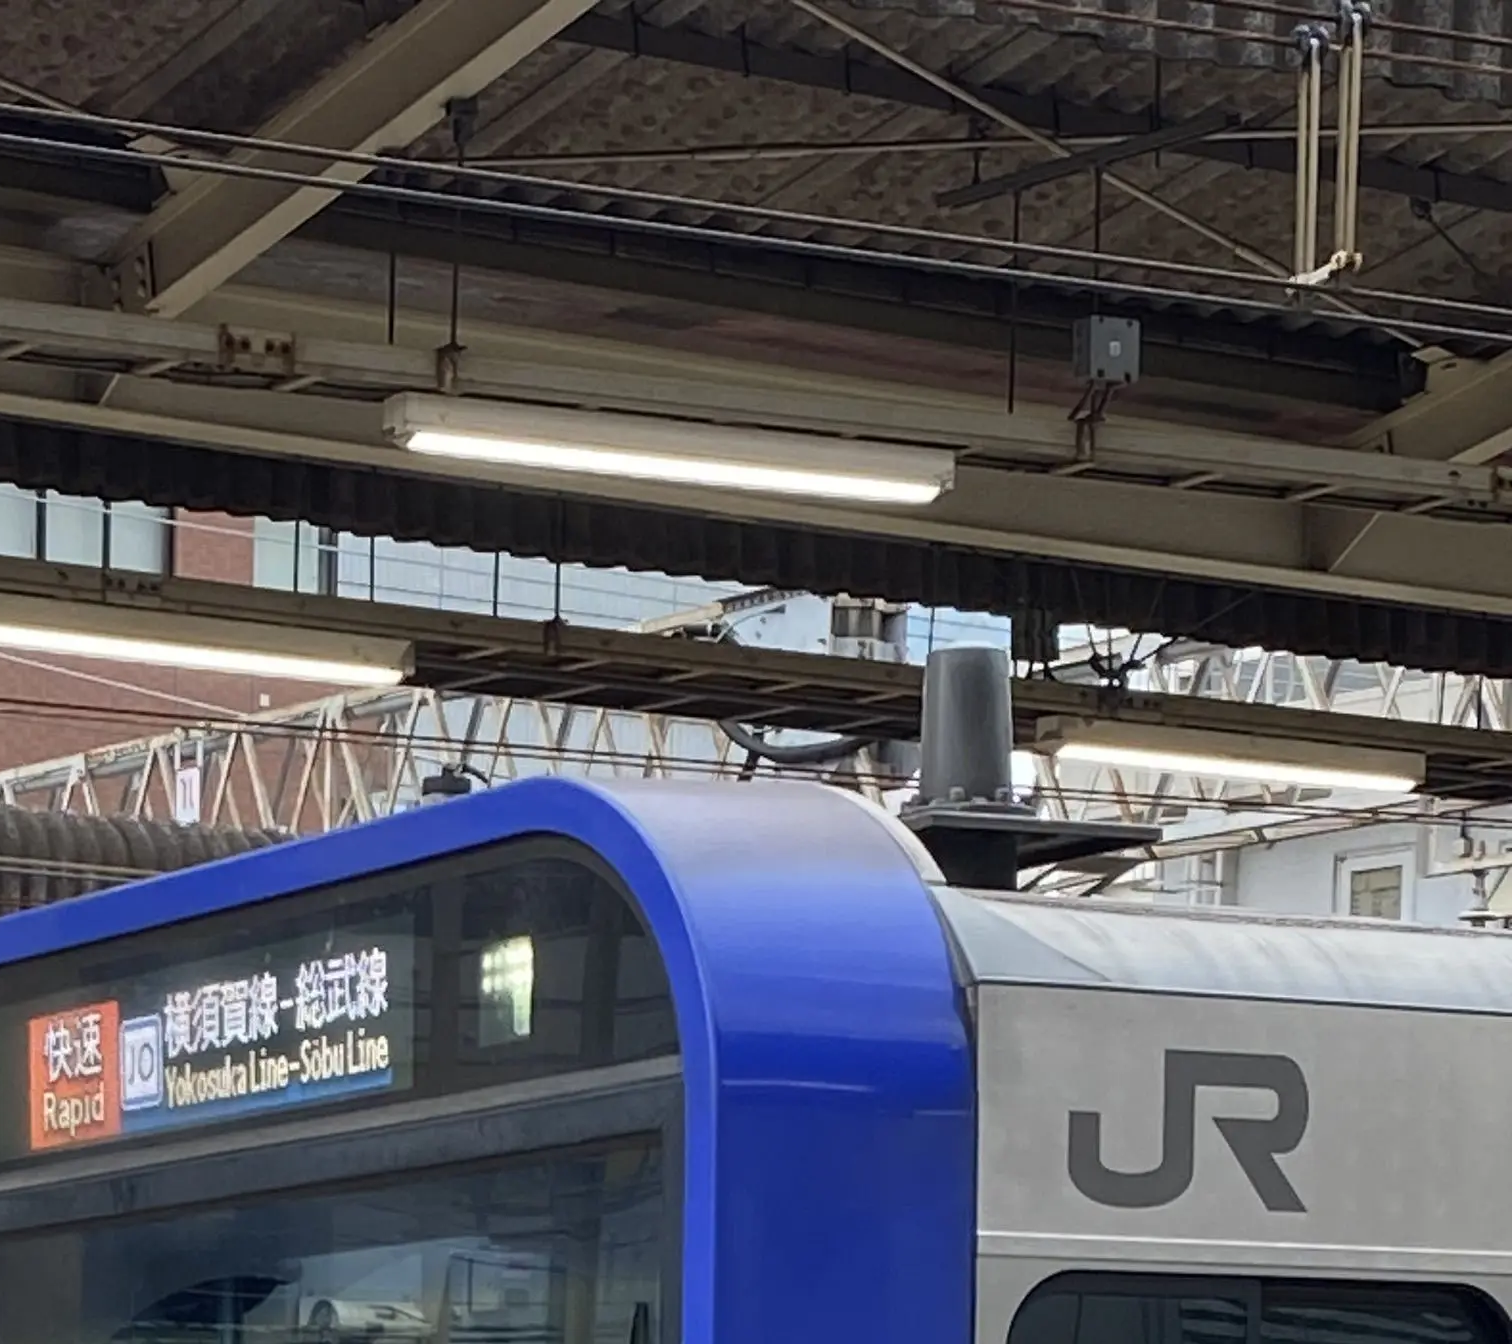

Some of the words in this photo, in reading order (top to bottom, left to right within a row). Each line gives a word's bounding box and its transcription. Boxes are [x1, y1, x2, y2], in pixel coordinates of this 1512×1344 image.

[44, 1013, 103, 1082] 快速
[165, 1054, 248, 1110] Yokosuka
[346, 1027, 389, 1075] Line
[43, 1080, 105, 1137] Rapid
[1067, 1048, 1309, 1213] JR
